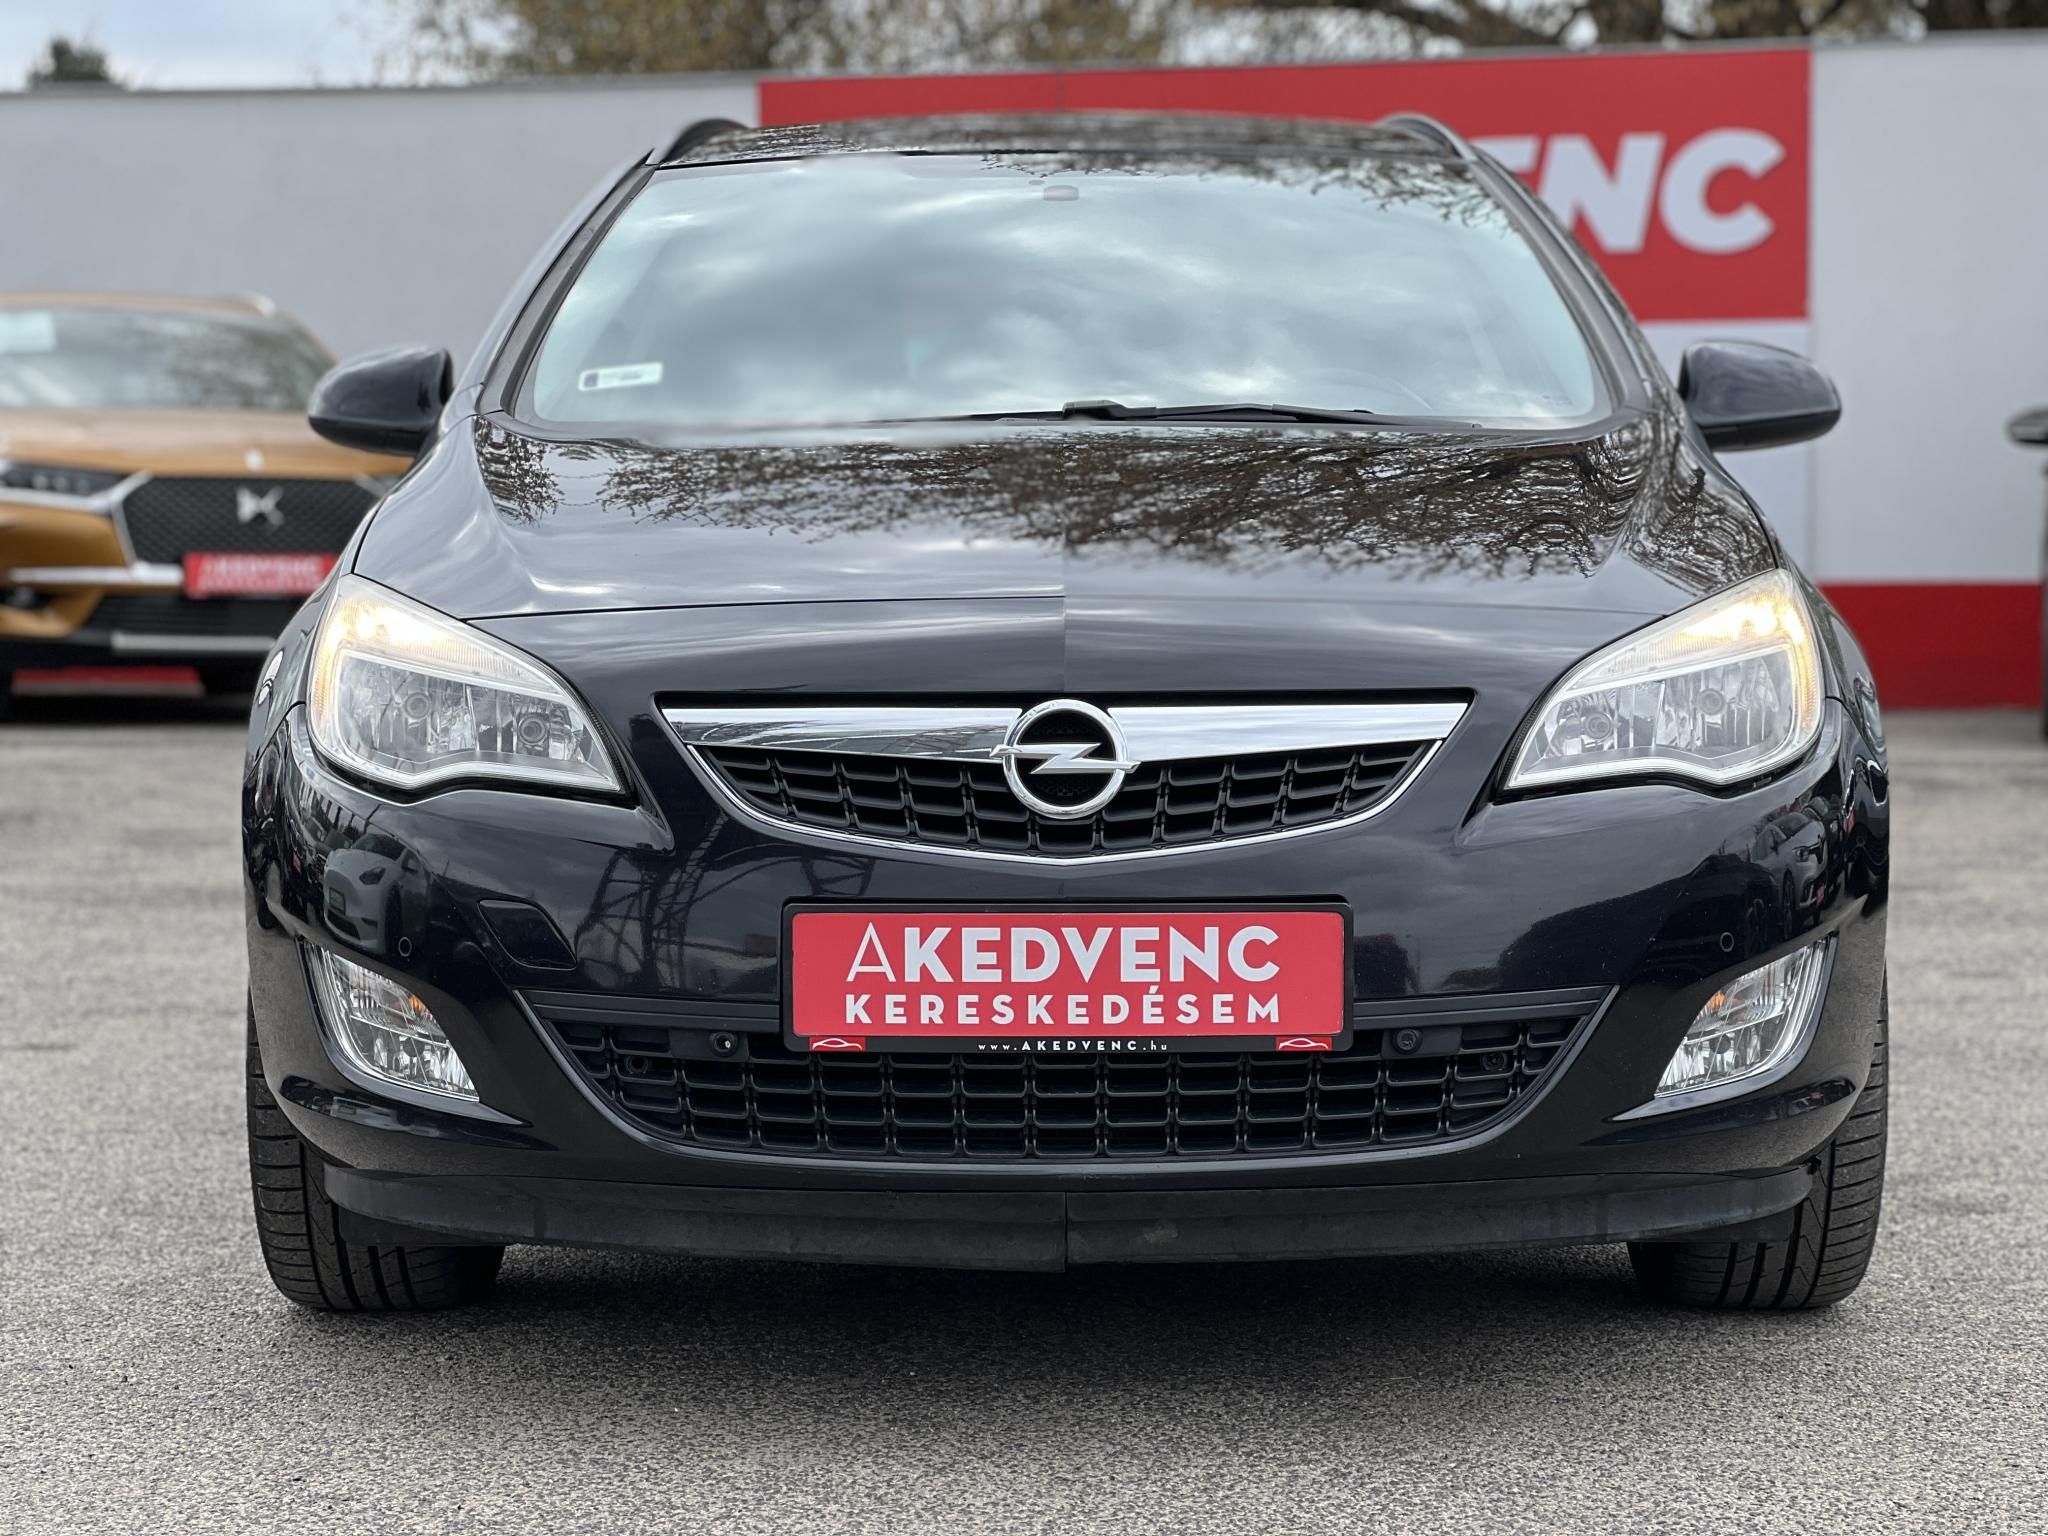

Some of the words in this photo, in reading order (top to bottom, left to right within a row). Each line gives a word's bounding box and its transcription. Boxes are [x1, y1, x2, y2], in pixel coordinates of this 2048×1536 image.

[846, 922, 1280, 982] AKEDVENC
[845, 985, 1280, 1025] KERESKEDÉSEM
[978, 1040, 1168, 1051] www.AKEDVENC.hu
